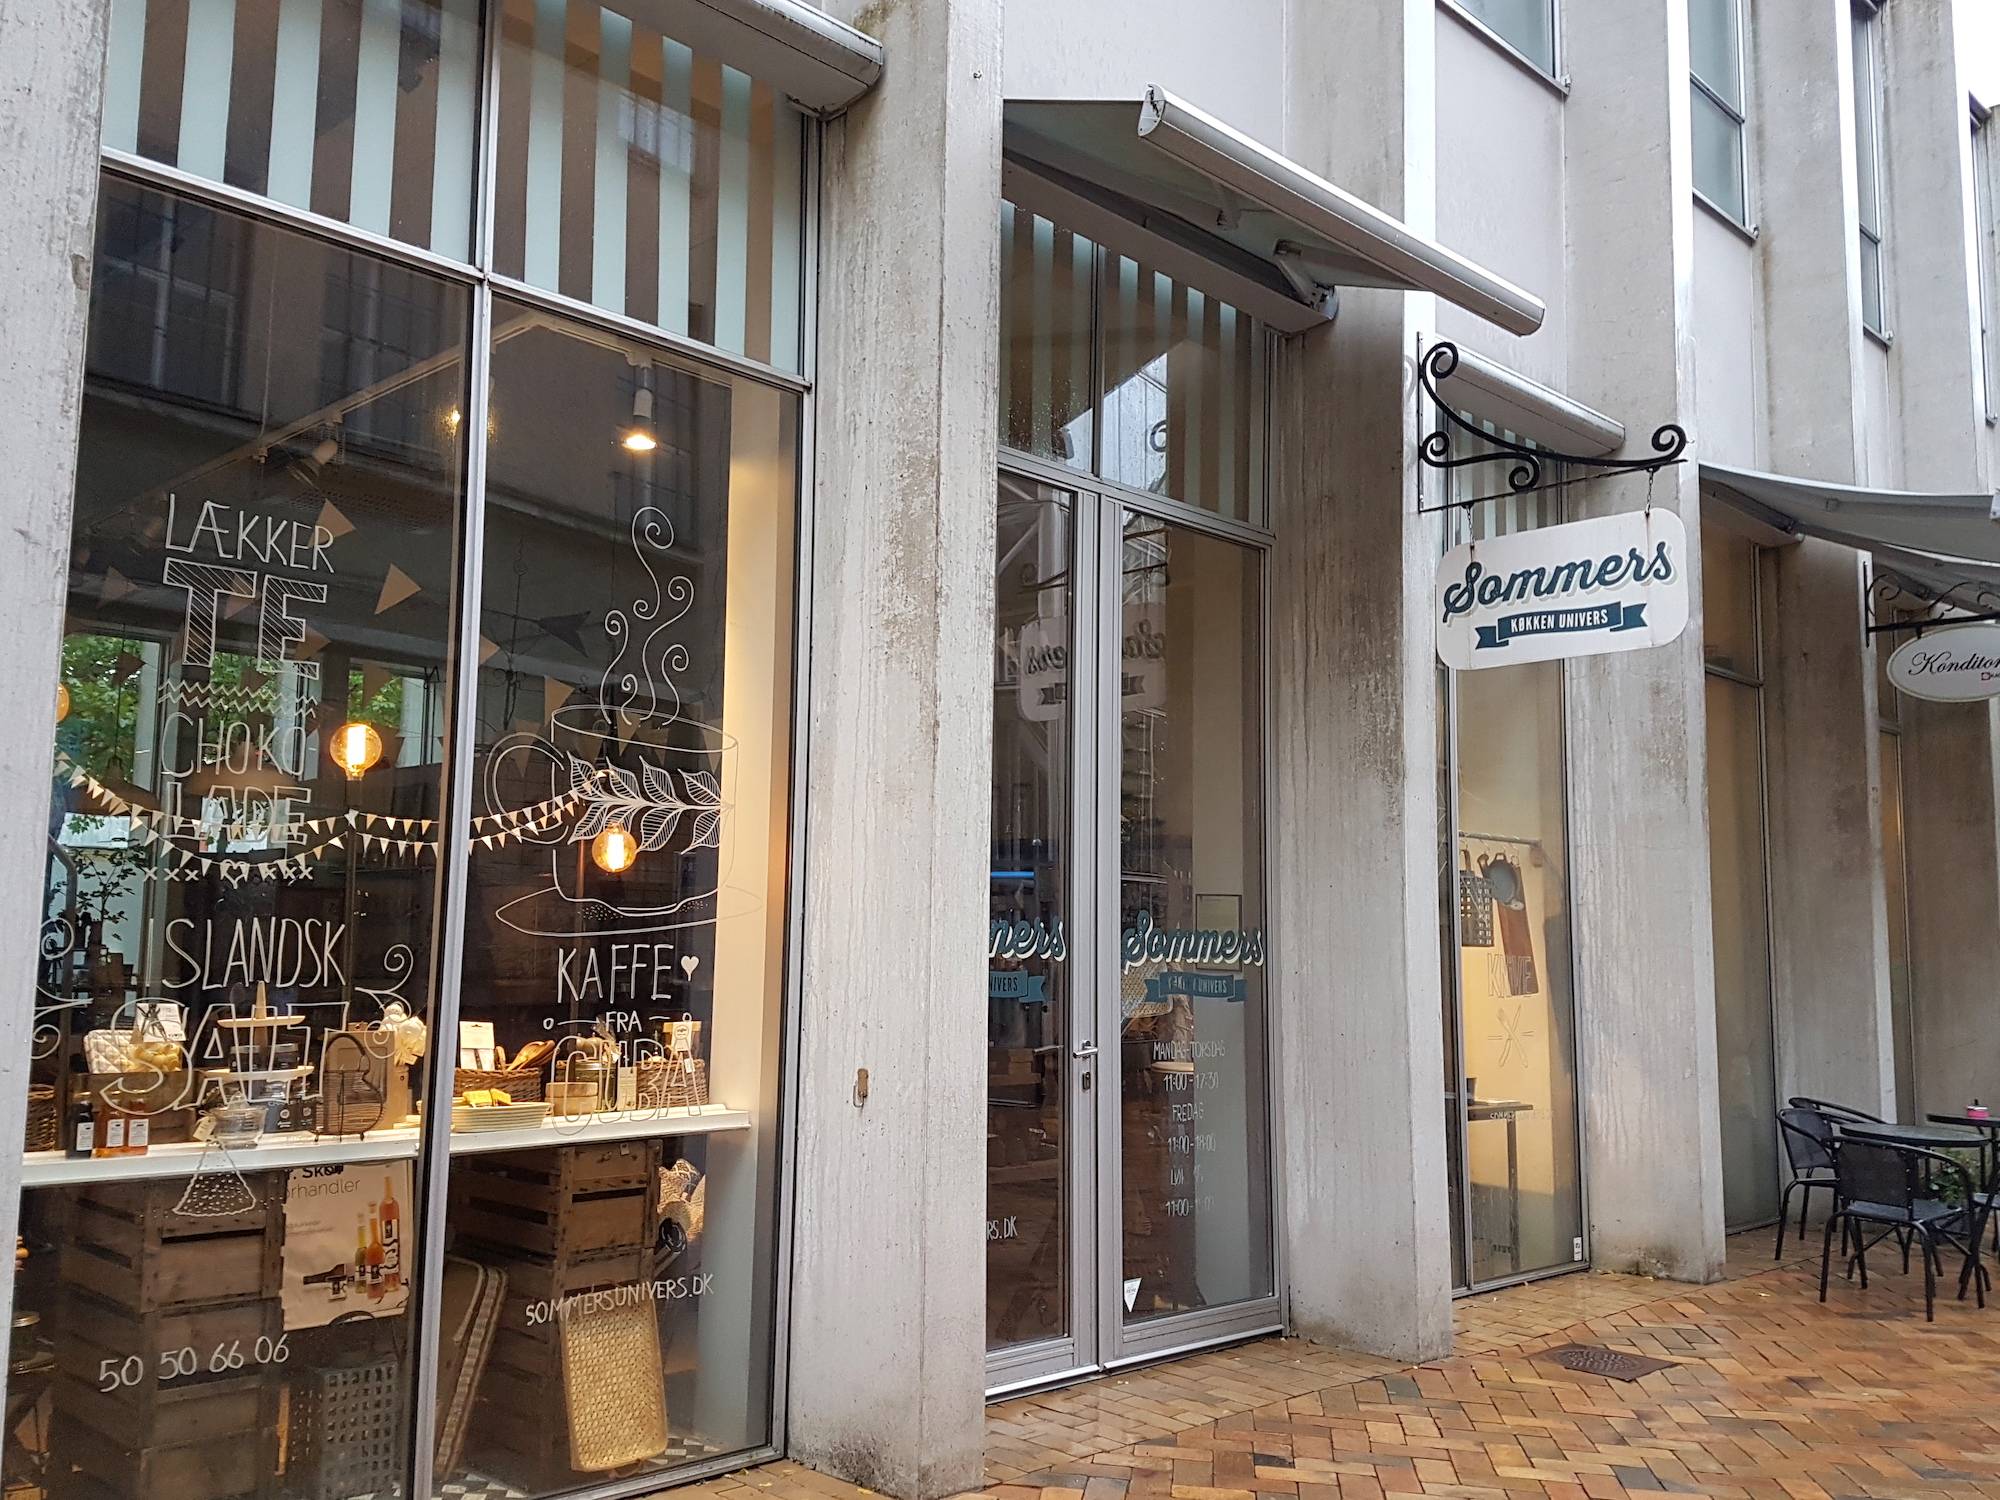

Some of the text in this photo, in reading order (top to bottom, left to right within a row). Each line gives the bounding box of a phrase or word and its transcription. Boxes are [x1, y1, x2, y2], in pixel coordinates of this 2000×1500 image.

[165, 493, 335, 573] LÆKKER
[1442, 541, 1675, 625] Sommers
[163, 557, 327, 680] TE
[1511, 609, 1608, 633] KØKKEN UNIVERS
[161, 712, 306, 778] CHOKO
[163, 781, 311, 845] LADE
[557, 944, 674, 1004] KAFFE
[1122, 909, 1264, 975] Sommers
[605, 1011, 642, 1033] FRA
[525, 1273, 714, 1327] SOMMERSUNIVERS.DK
[99, 1333, 289, 1393] 50 50 66 06
